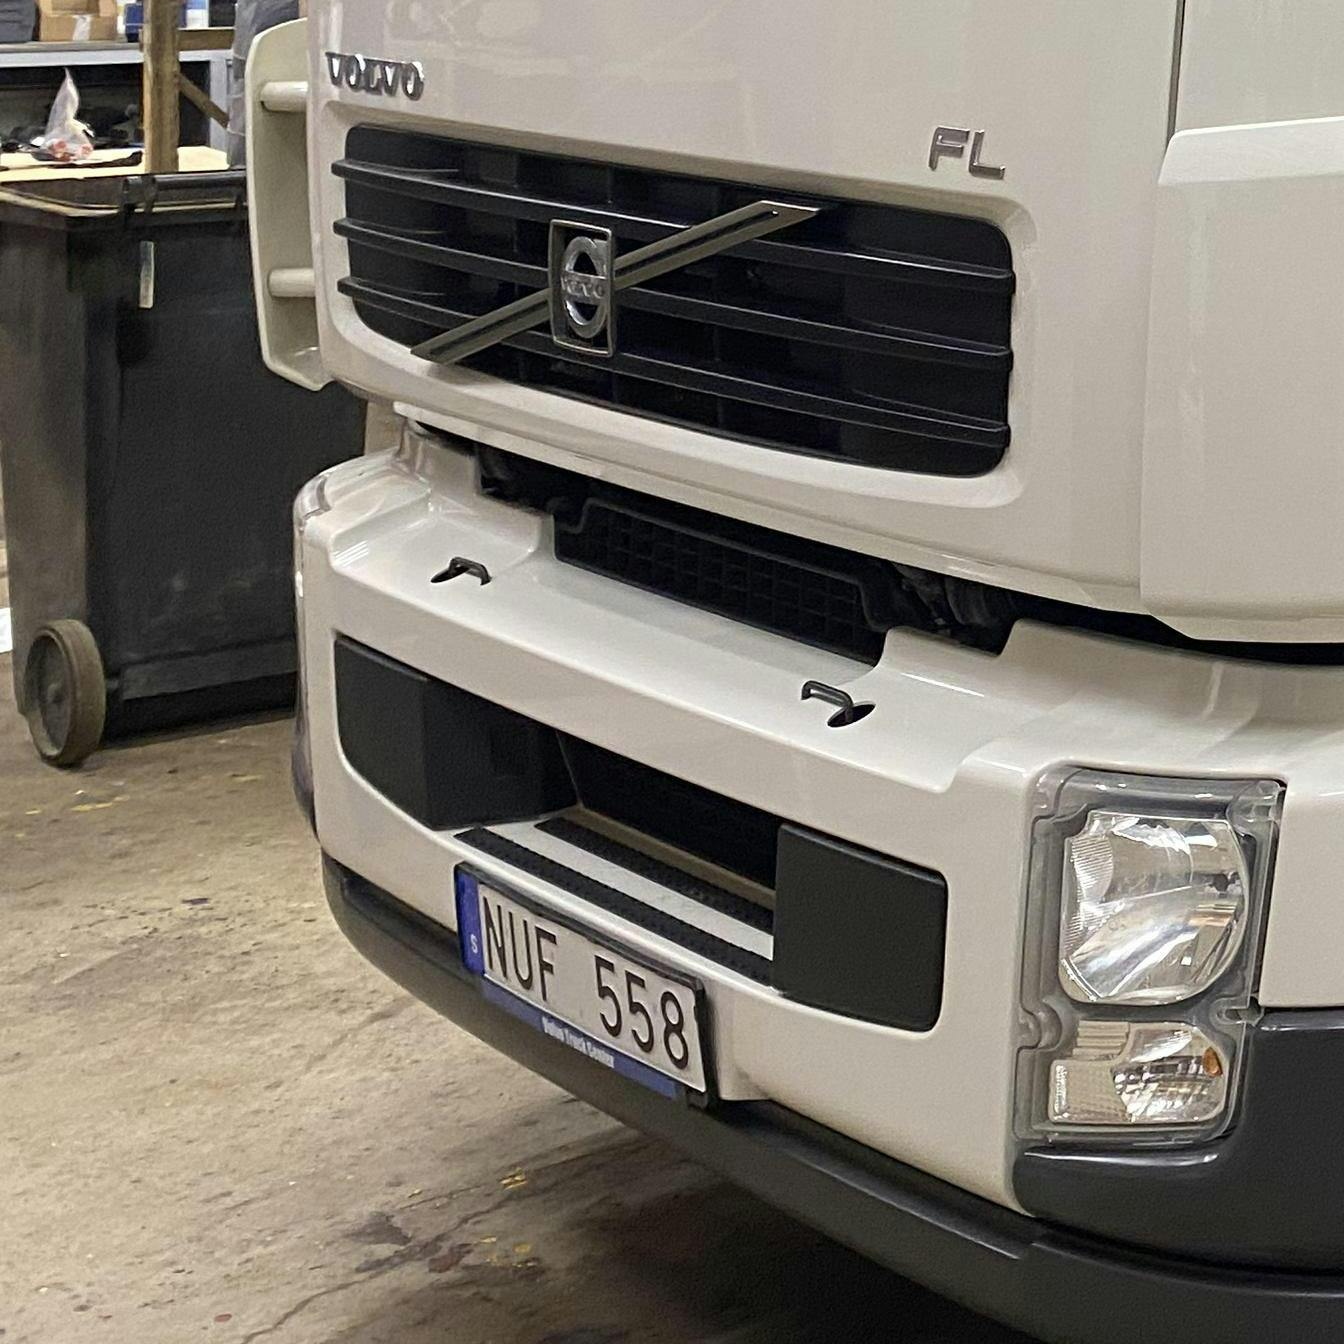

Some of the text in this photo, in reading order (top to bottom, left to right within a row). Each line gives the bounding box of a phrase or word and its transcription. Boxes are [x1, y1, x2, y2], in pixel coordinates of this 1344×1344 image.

[325, 51, 425, 102] VOLVO
[928, 125, 1006, 181] FL
[470, 933, 479, 954] S
[482, 895, 690, 1071] NUF 558
